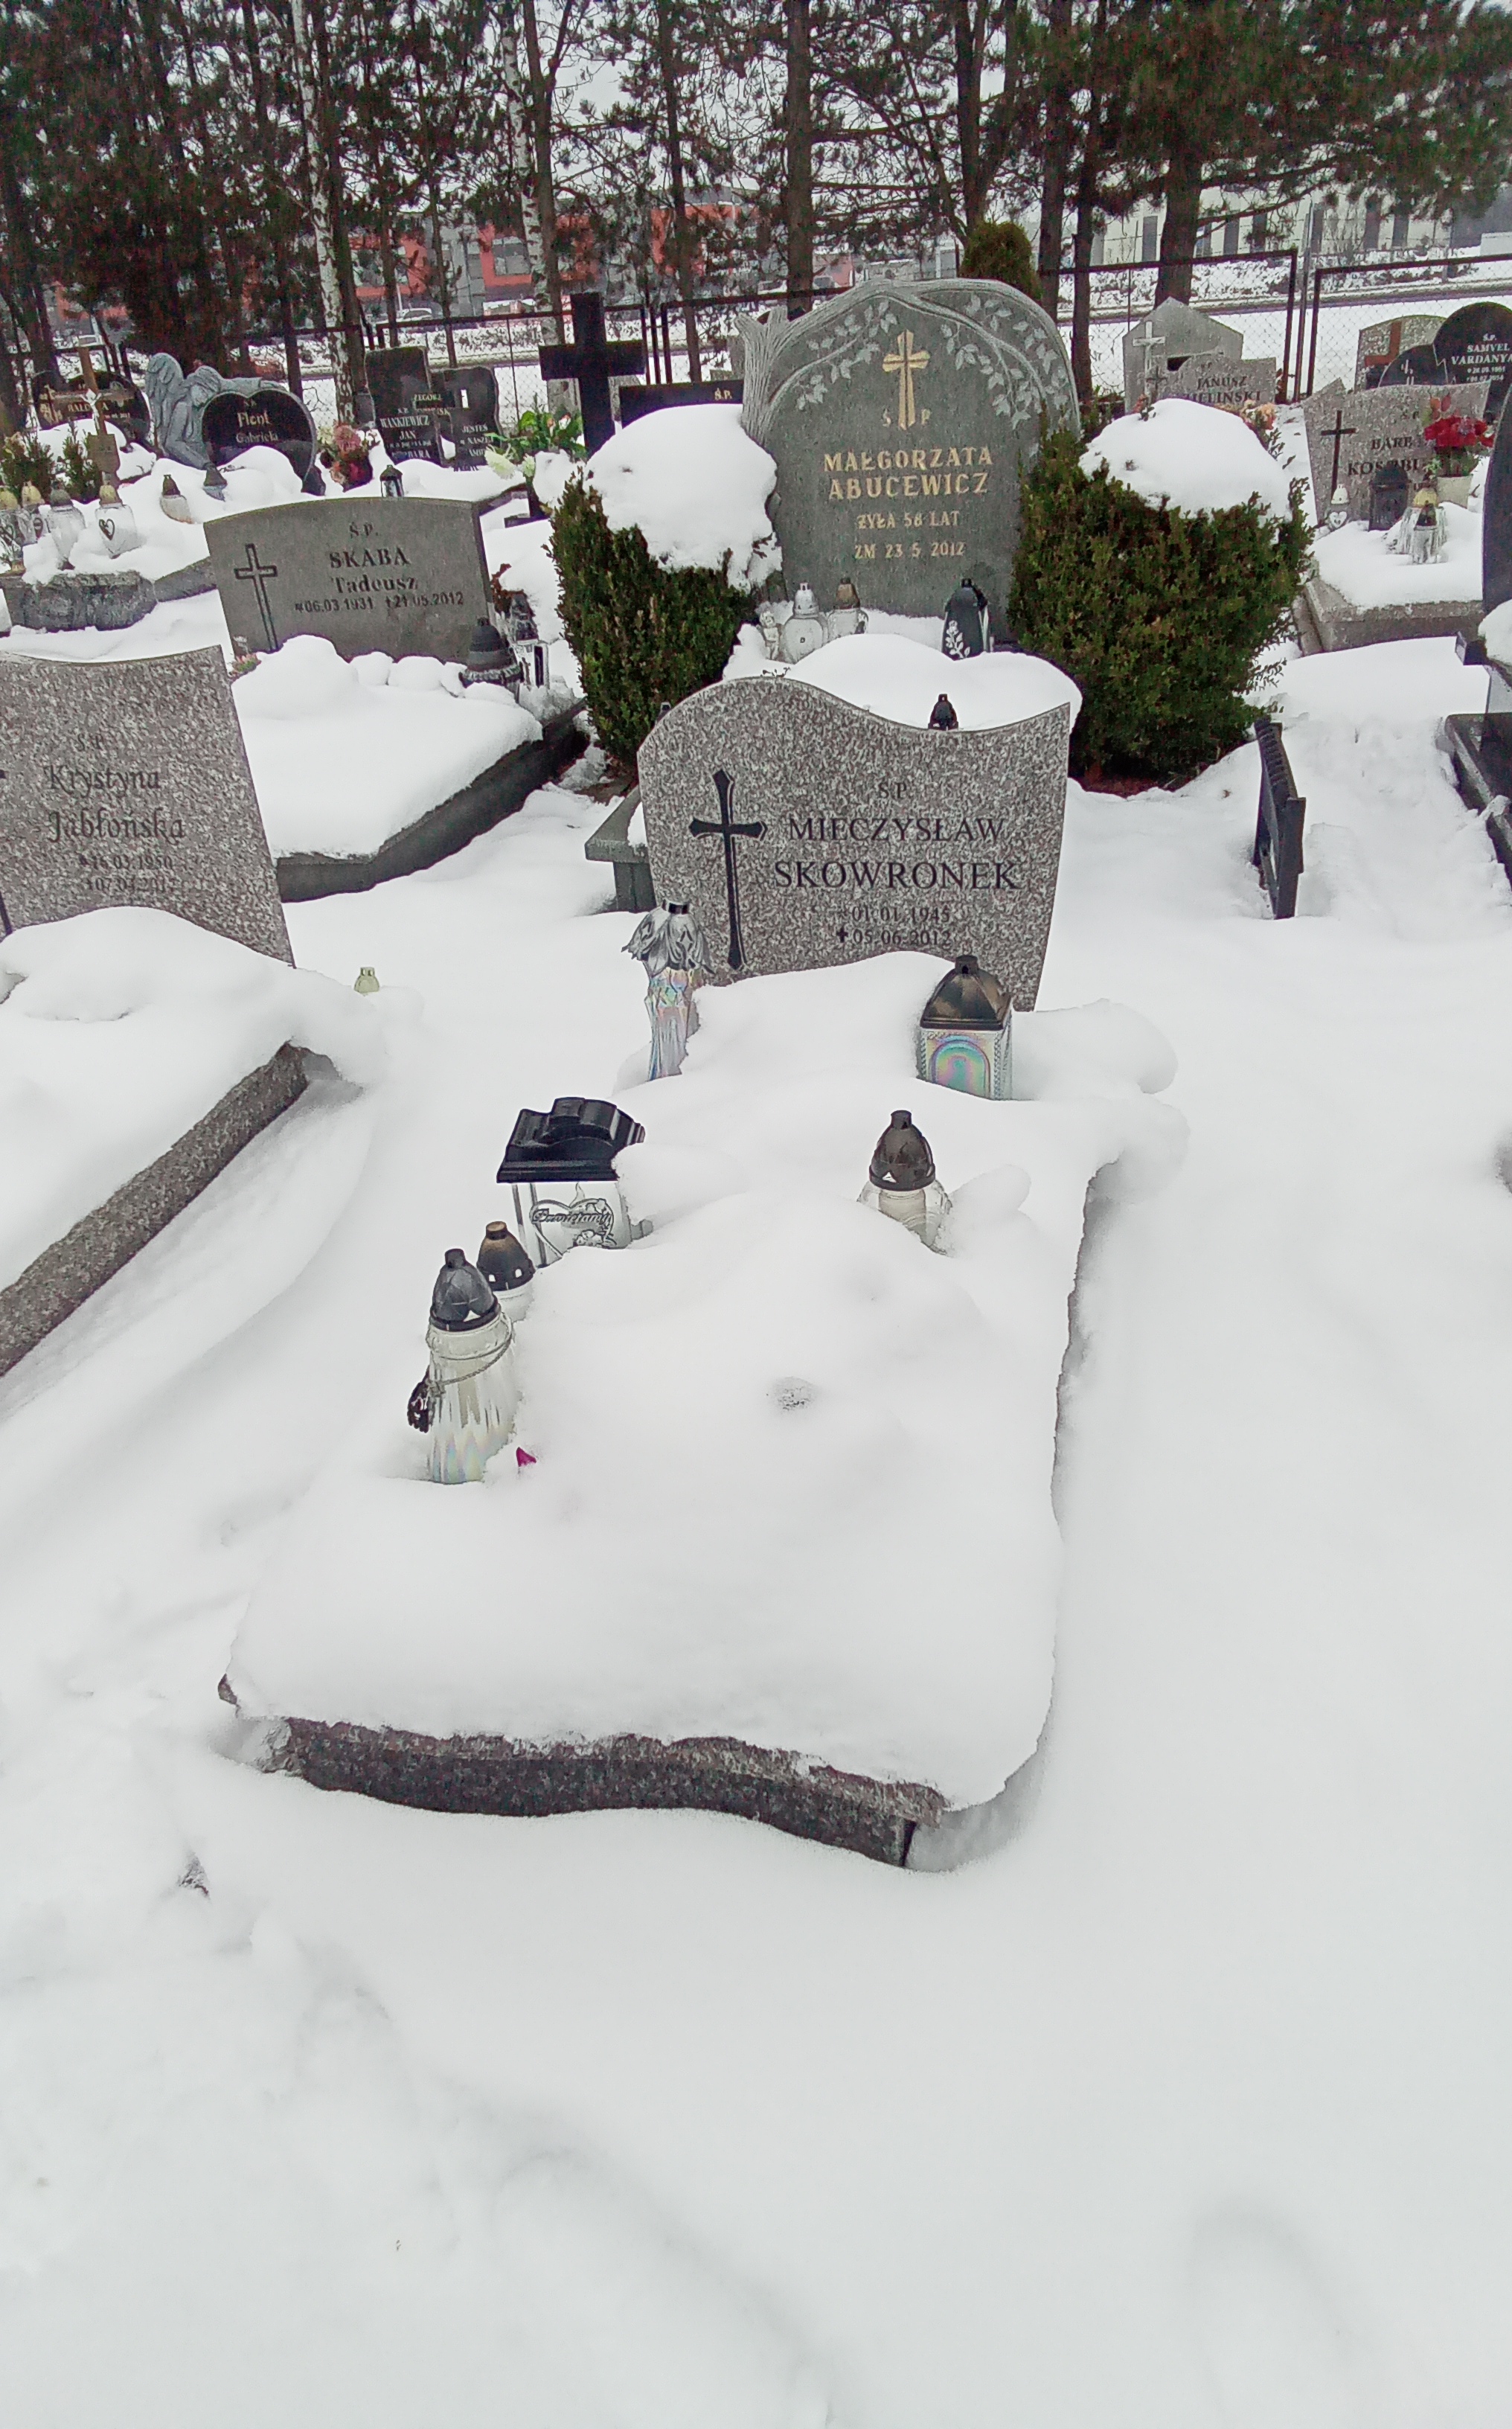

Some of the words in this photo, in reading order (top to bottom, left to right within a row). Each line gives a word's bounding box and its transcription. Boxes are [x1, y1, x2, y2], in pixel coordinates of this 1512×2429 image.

[824, 447, 993, 473] MAŁGORZATA
[828, 472, 990, 501] ABUCEWICZ
[929, 510, 960, 528] LAT
[329, 545, 411, 569] SKABA
[931, 540, 967, 557] 2012
[331, 574, 418, 595] Tadeusz
[43, 764, 161, 799] Krystyna
[48, 807, 186, 846] Jabłońska
[789, 817, 1004, 844] MIECZYSŁAW
[775, 860, 1024, 890] SKOWRONEK
